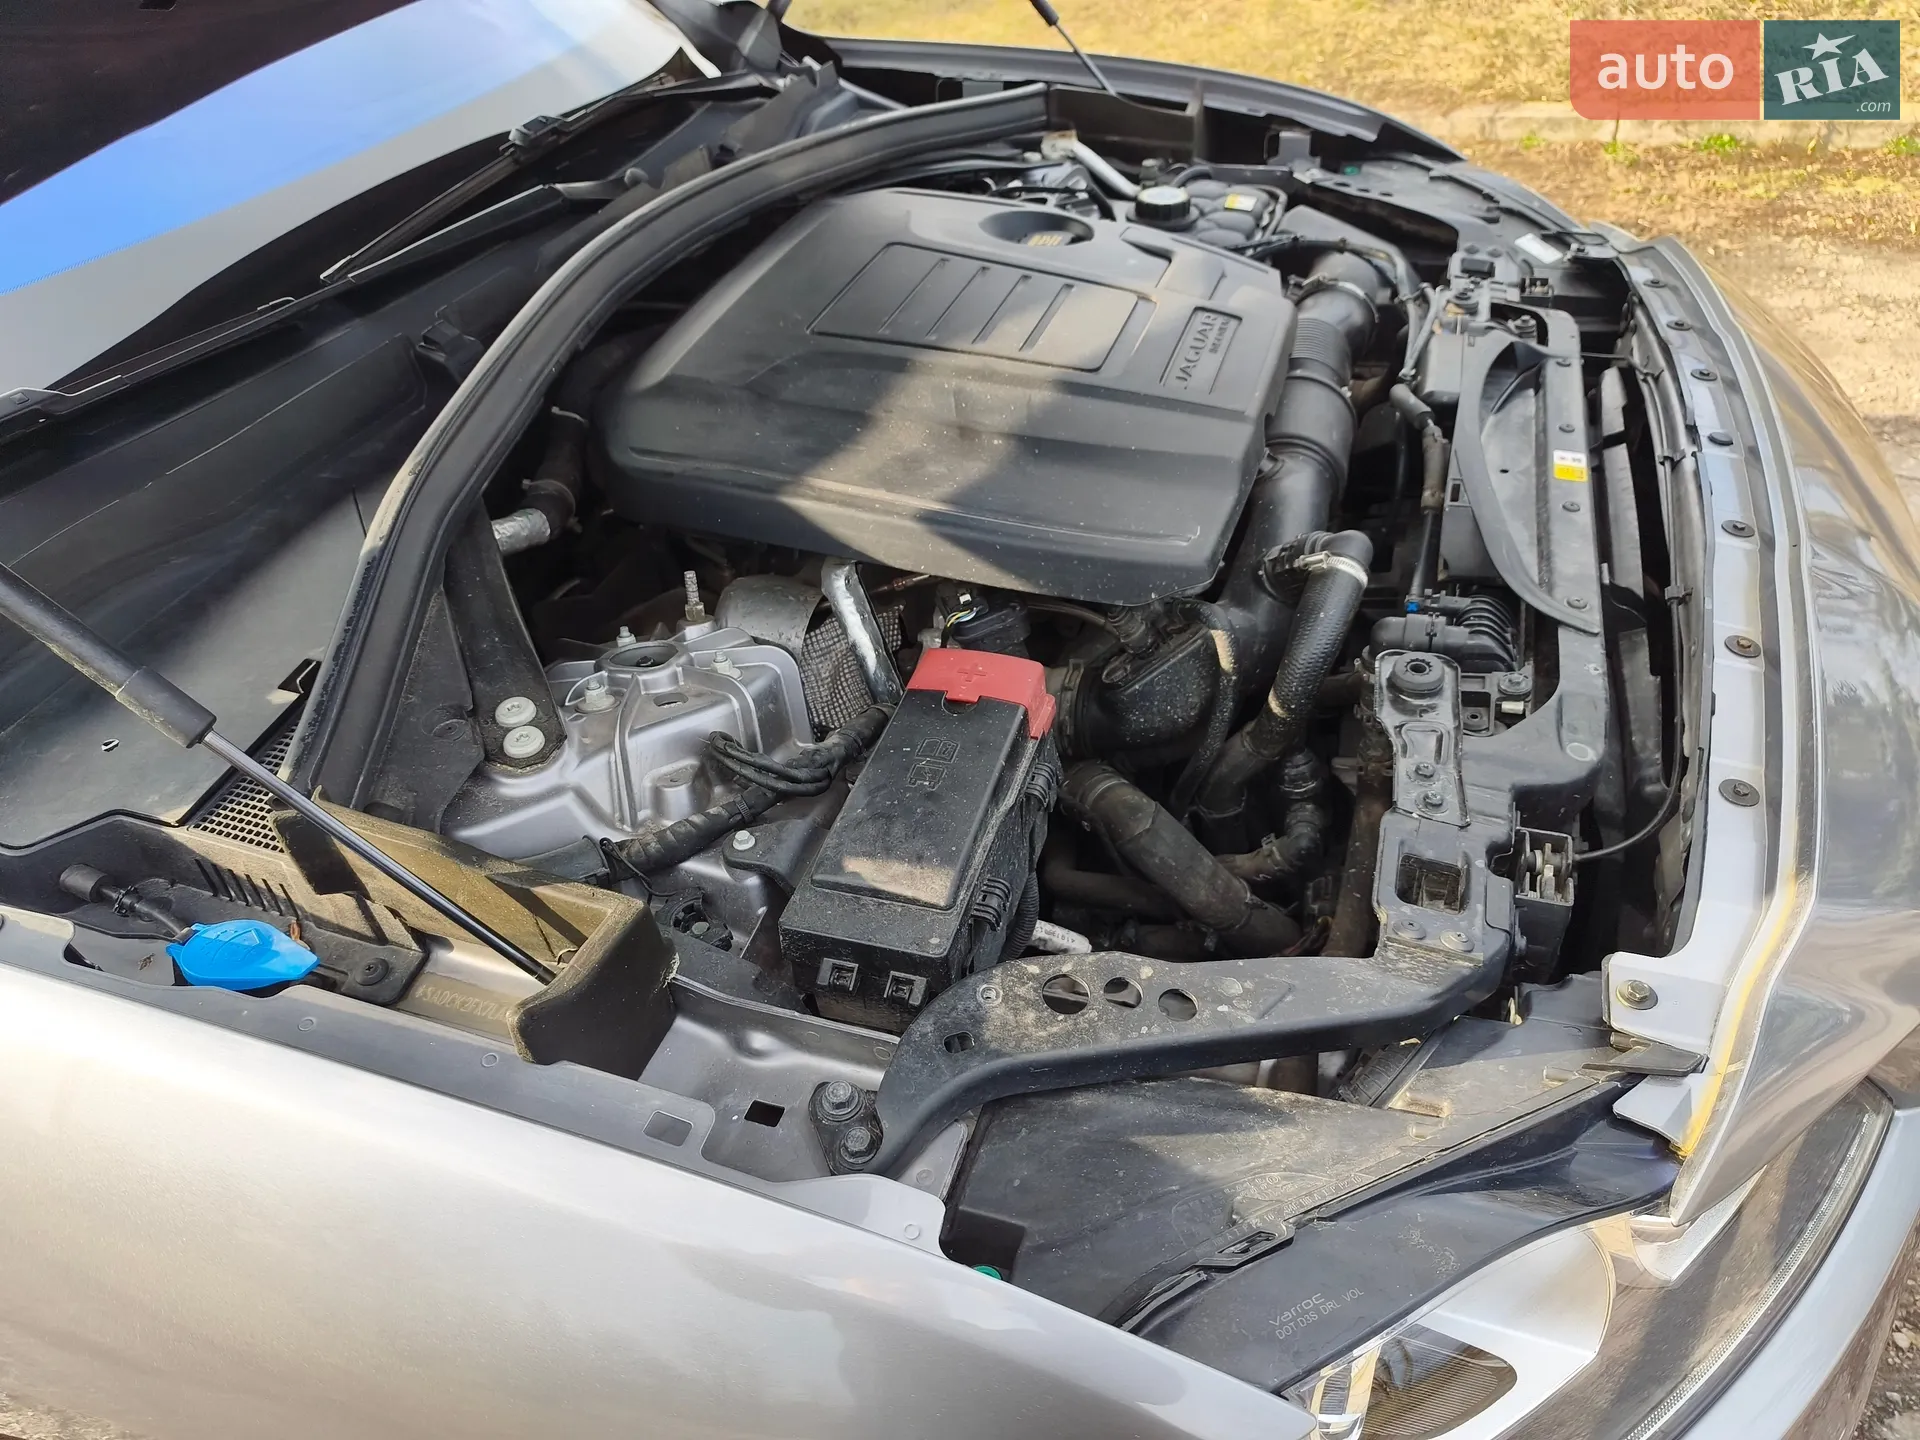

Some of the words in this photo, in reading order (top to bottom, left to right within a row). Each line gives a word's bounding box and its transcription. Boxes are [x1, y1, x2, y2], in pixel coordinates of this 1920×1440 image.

[1175, 313, 1219, 390] JAGUAR
[1268, 1292, 1325, 1326] varroc
[1275, 1323, 1297, 1340] DOT
[1297, 1310, 1318, 1328] D3S
[1319, 1299, 1341, 1316] DRL
[1341, 1287, 1365, 1302] VOL
